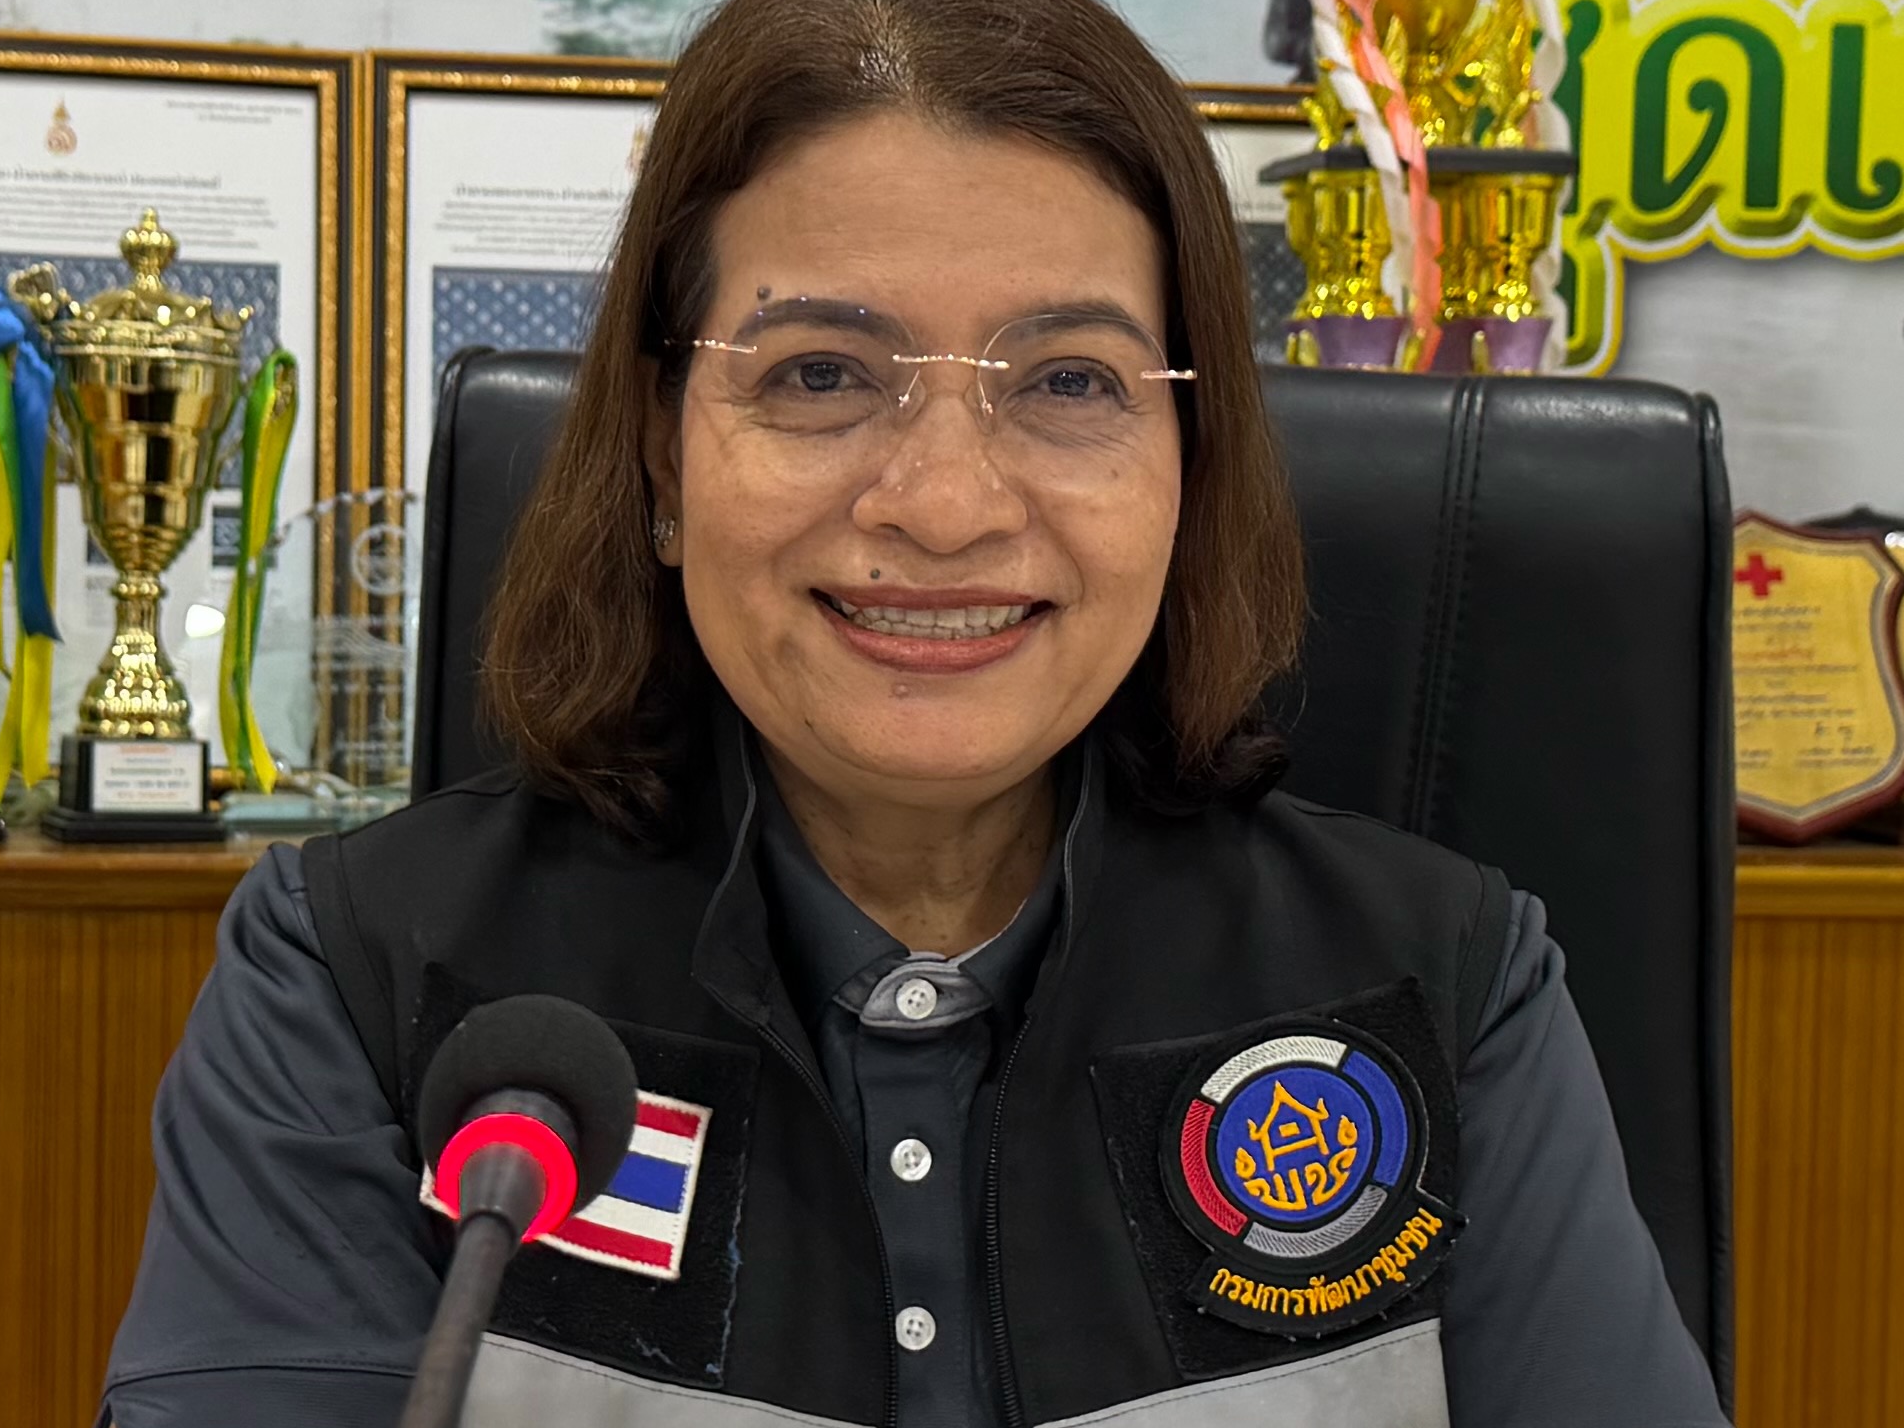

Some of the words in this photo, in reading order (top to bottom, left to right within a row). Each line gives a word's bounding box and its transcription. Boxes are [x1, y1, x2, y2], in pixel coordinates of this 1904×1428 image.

[1208, 1207, 1443, 1316] กรมการพัฒนาชุมชน
